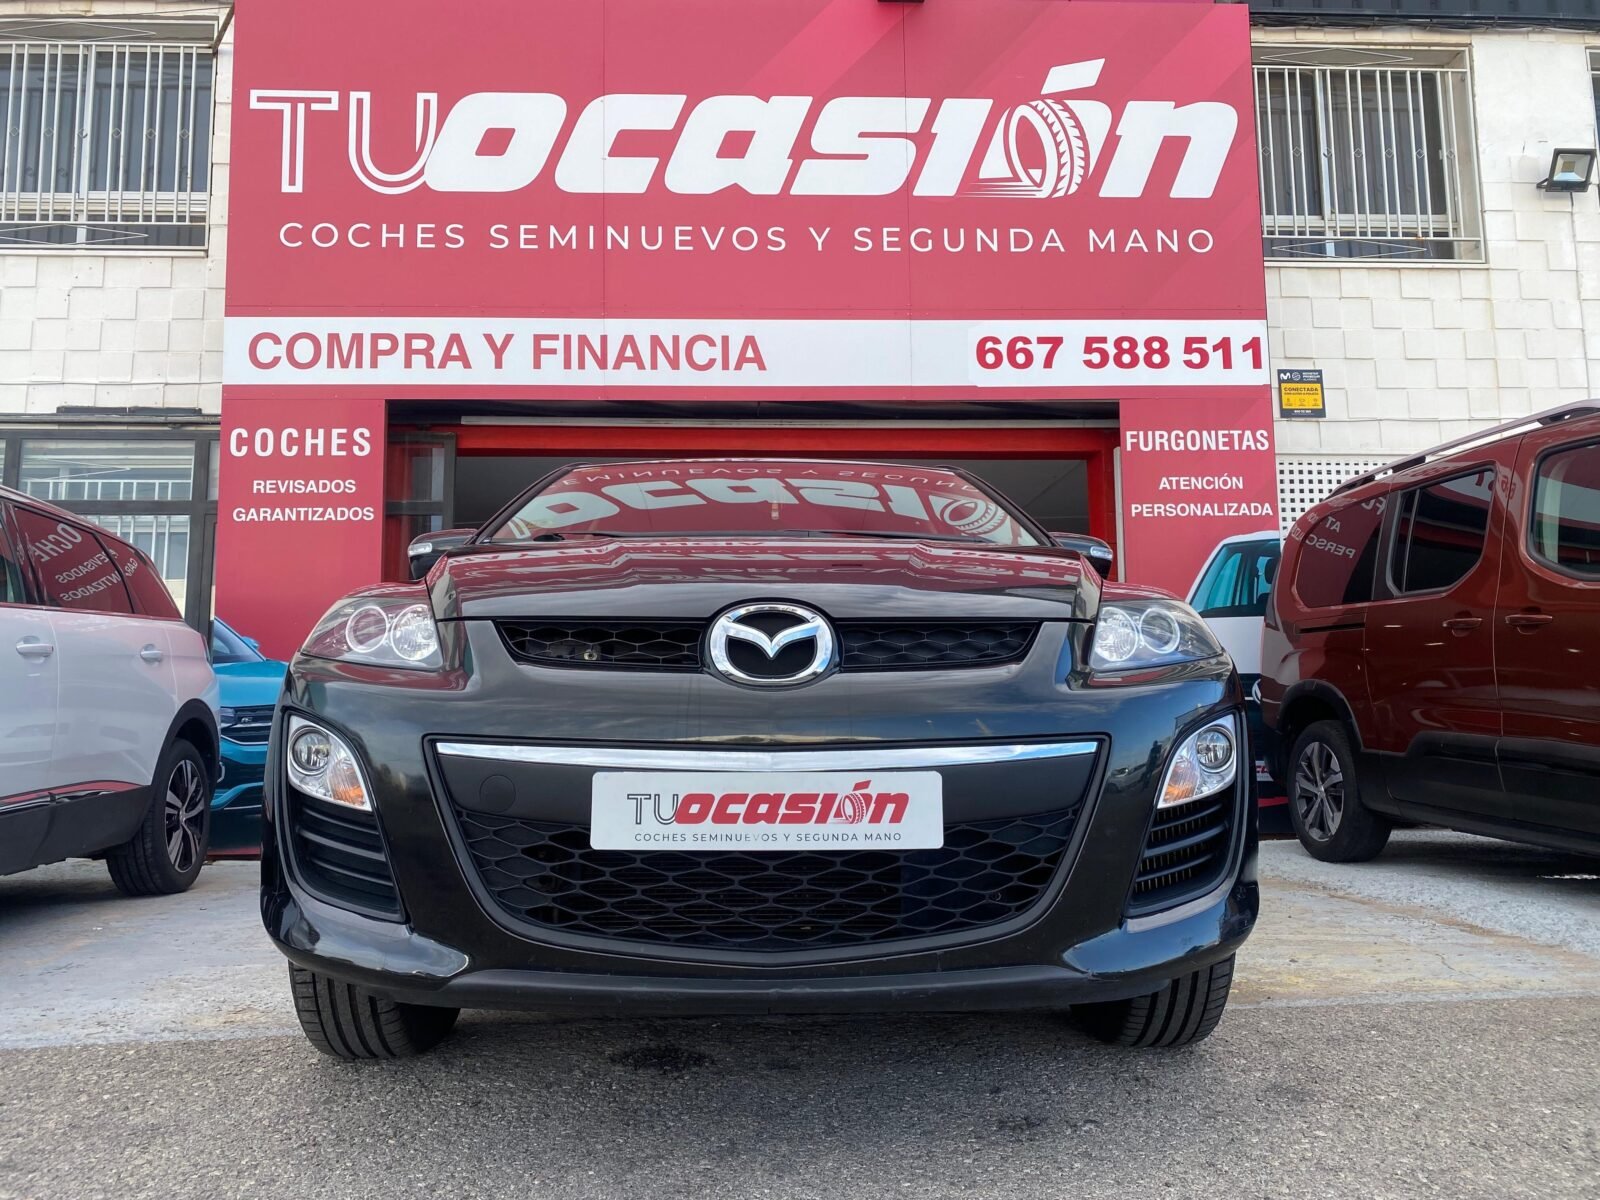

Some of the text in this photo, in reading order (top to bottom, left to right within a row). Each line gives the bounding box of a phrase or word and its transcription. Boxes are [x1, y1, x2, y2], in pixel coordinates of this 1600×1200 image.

[279, 222, 1214, 253] COCHES SEMINUEVOS Y SEGUNDA MANO
[248, 331, 767, 371] COMPRA Y FINANCIA
[975, 335, 1263, 370] 667 588 511
[229, 427, 371, 457] COCHES
[1125, 430, 1270, 453] FURGONETAS
[252, 479, 357, 494] REVISADOS
[1158, 473, 1244, 490] ATENCIÓN
[232, 507, 375, 522] GARANTIZADOS
[1130, 503, 1274, 518] PERSONALIZADA
[634, 832, 902, 843] COCHES SEMINUEVOS Y SEGUNDA MANO
